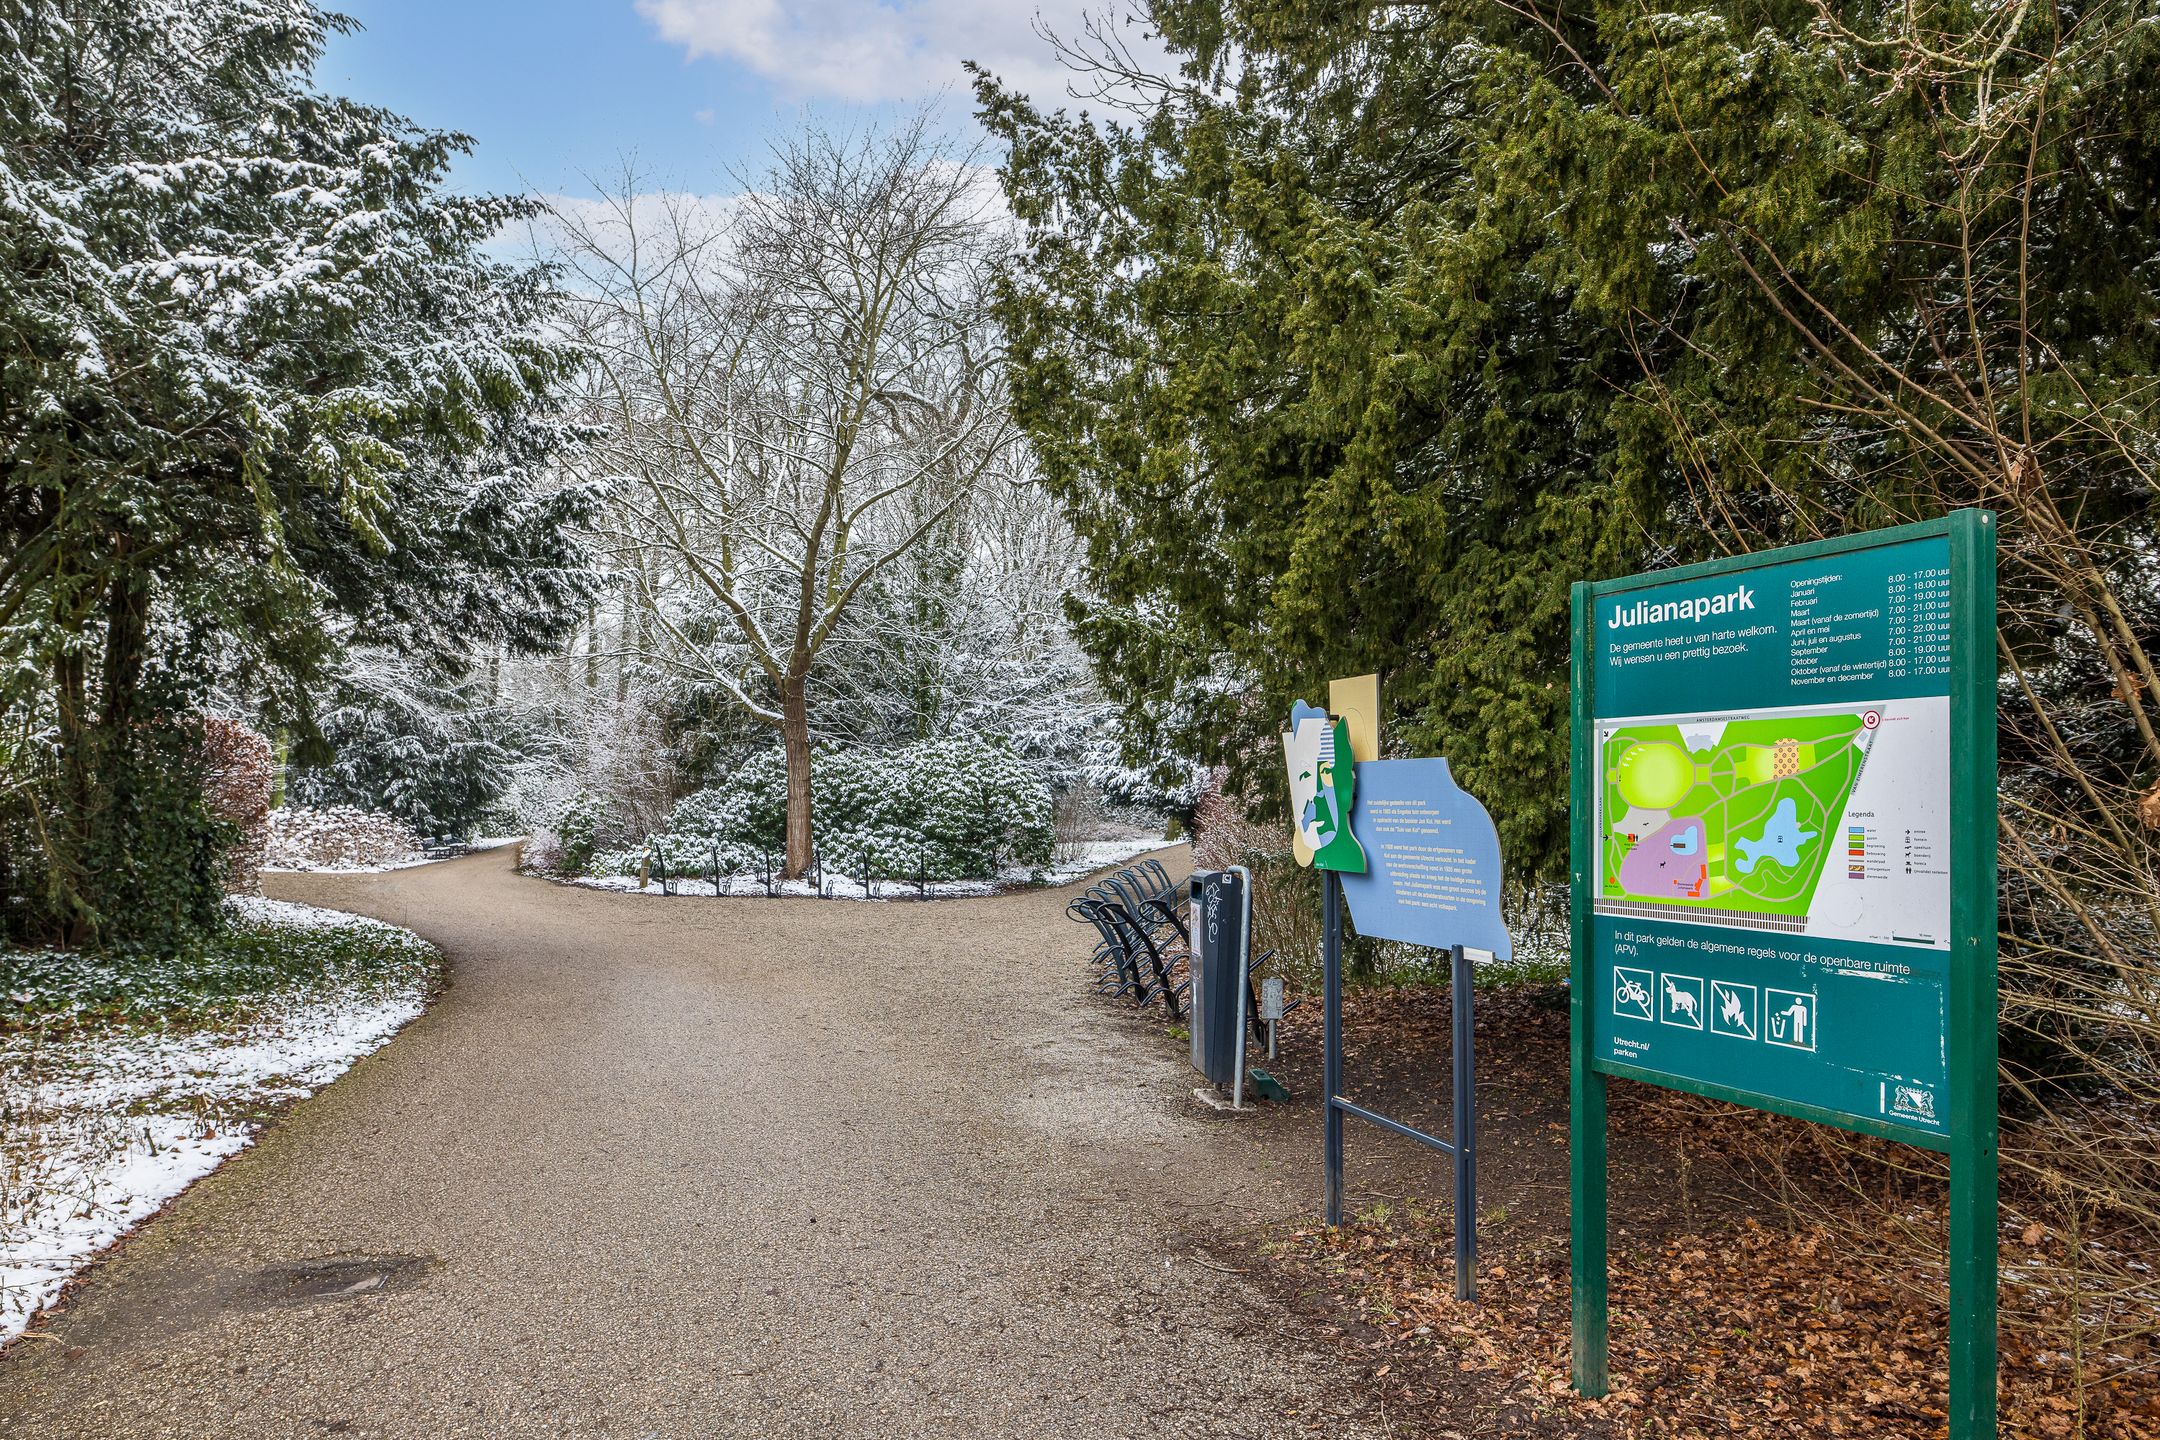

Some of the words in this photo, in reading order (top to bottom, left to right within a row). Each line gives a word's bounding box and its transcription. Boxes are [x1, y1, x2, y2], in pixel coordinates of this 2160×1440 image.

[1791, 574, 1842, 588] Openingstijden:
[1791, 588, 1814, 597] Januari
[1888, 574, 1905, 583] 8.00
[1913, 569, 1936, 579] 17.00
[1791, 597, 1818, 607] Februari
[1888, 585, 1905, 594] 8.00
[1913, 580, 1936, 590] 18.00
[1791, 608, 1810, 616] Maart
[1888, 595, 1905, 604] 7.00
[1913, 590, 1936, 600] 19.00
[1608, 586, 1755, 629] Julianapark
[1791, 618, 1810, 627] Maart
[1812, 615, 1832, 625] (vanaf
[1834, 613, 1843, 622] de
[1844, 609, 1879, 620] zomertijd)
[1888, 606, 1905, 615] 7.00
[1913, 601, 1936, 611] 21.00
[1791, 628, 1805, 637] April
[1888, 617, 1905, 625] 7.00
[1913, 613, 1936, 622] 21.00
[1791, 638, 1806, 647] Juni,
[1808, 636, 1817, 646] juli
[1829, 633, 1861, 643] augustus
[1888, 627, 1905, 635] 7.00
[1913, 624, 1936, 632] 22.00
[1610, 643, 1621, 653] De
[1623, 637, 1663, 653] gemeente
[1665, 636, 1683, 646] heet
[1686, 636, 1692, 644] u
[1694, 632, 1709, 642] van
[1712, 629, 1735, 641] harte
[1738, 624, 1777, 637] welkom.
[1791, 646, 1828, 657] September
[1888, 638, 1905, 646] 7.00
[1913, 634, 1936, 643] 21.00
[1610, 657, 1622, 667] Wij
[1624, 653, 1654, 665] wensen
[1657, 653, 1662, 661] u
[1665, 651, 1680, 660] een
[1683, 646, 1710, 660] prettig
[1713, 642, 1748, 655] bezoek.
[1791, 658, 1818, 666] Oktober
[1888, 648, 1905, 656] 8.00
[1913, 646, 1936, 654] 19.00
[1791, 667, 1818, 676] Oktober
[1820, 665, 1840, 674] (vanaf
[1852, 660, 1886, 670] wintertijd)
[1791, 677, 1825, 685] November
[1838, 673, 1873, 681] december
[1614, 944, 1638, 956] (APV).
[1615, 931, 1622, 940] In
[1624, 932, 1634, 941] dit
[1637, 933, 1654, 944] park
[1657, 935, 1684, 947] gelden
[1687, 939, 1698, 949] de
[1701, 940, 1745, 954] algemene
[1748, 947, 1776, 959] regels
[1778, 951, 1801, 961] voor
[1804, 953, 1817, 963] de
[1820, 956, 1870, 970] openbare
[1874, 962, 1910, 975] ruimte
[1614, 1037, 1650, 1050] Utrecht.nl/
[1614, 1048, 1637, 1058] parken
[1888, 1110, 1918, 1122] Gemeente
[1918, 1117, 1940, 1126] Utrecht
